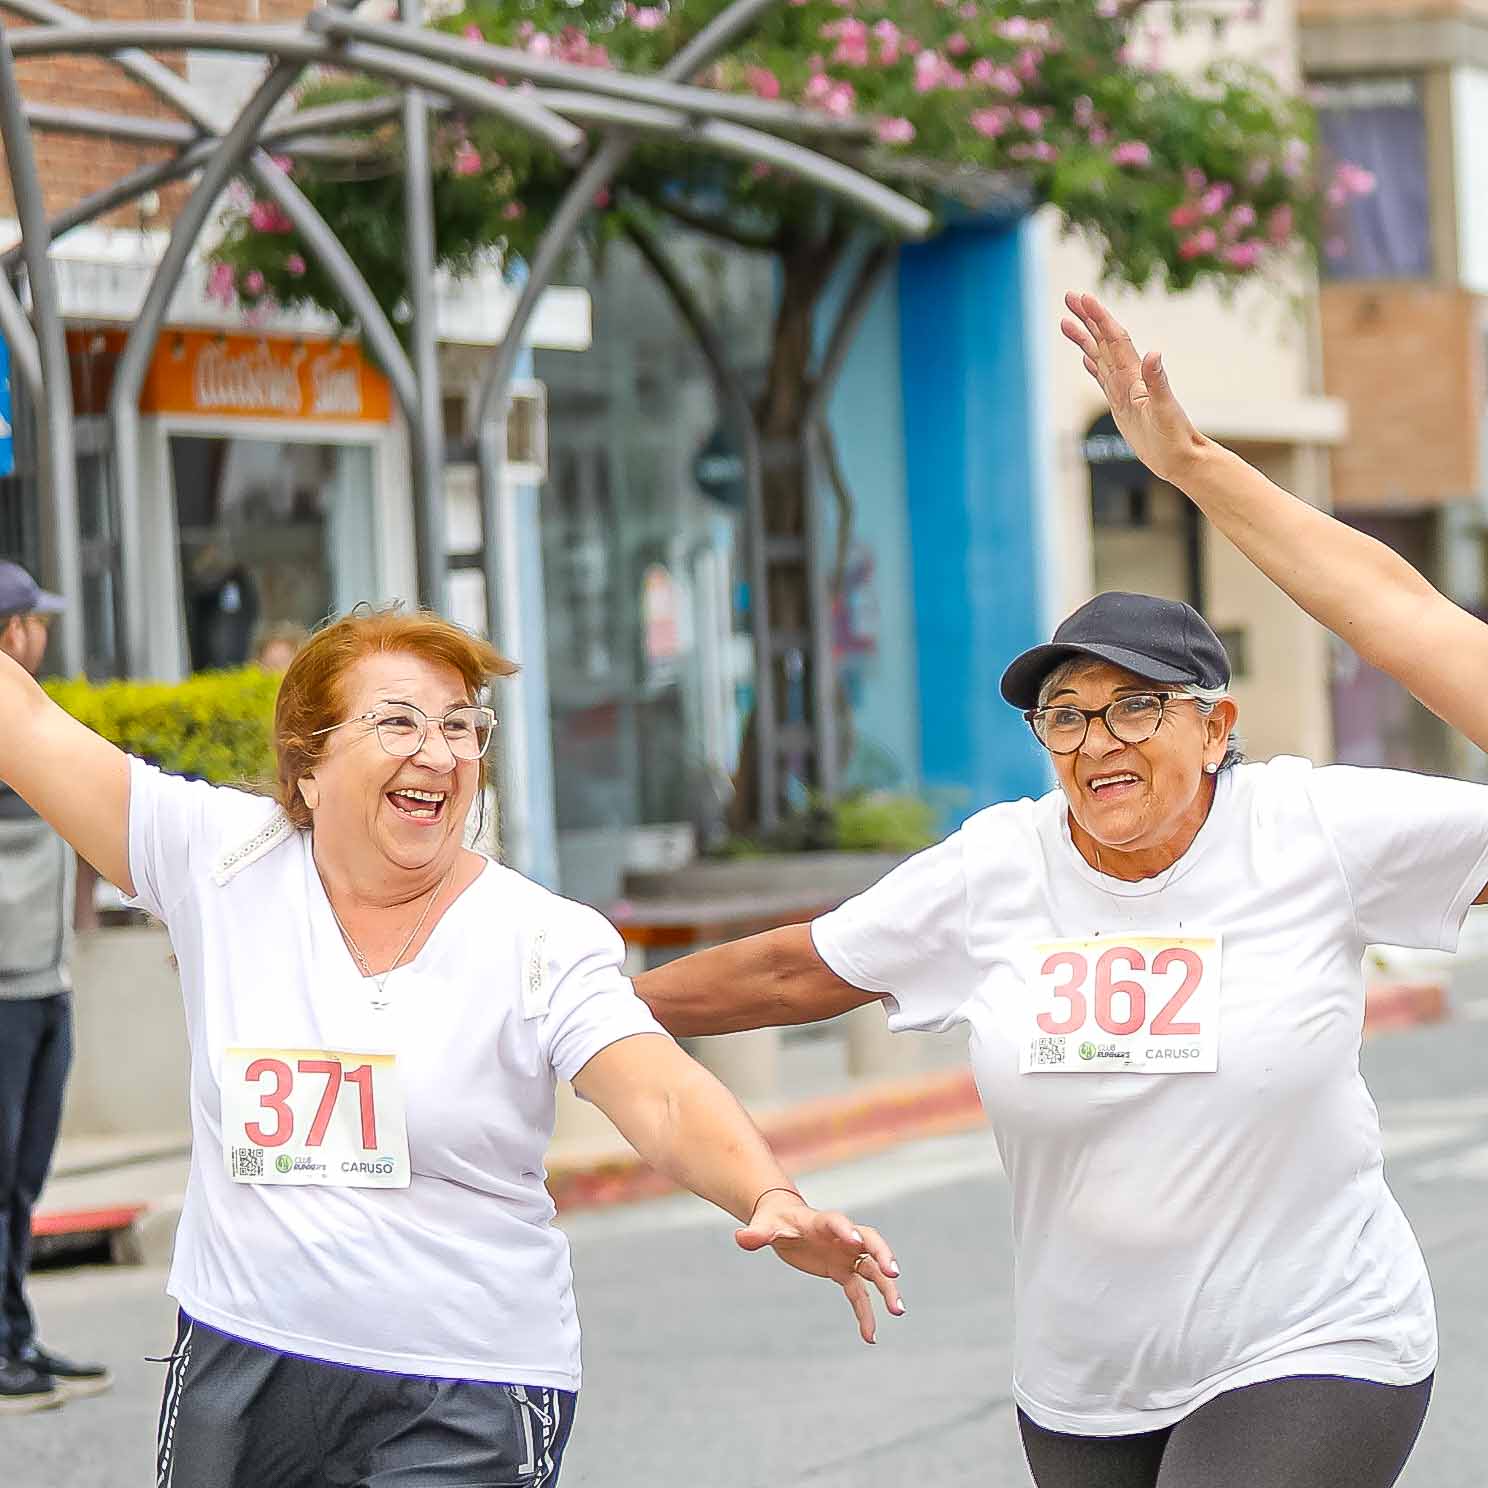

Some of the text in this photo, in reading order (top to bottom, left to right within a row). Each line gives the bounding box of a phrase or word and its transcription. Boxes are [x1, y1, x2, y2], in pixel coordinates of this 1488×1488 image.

[1036, 946, 1204, 1036] 362
[1145, 1048, 1200, 1060] CARUSO
[244, 1058, 378, 1150] 371
[341, 1162, 393, 1174] CARUSO
